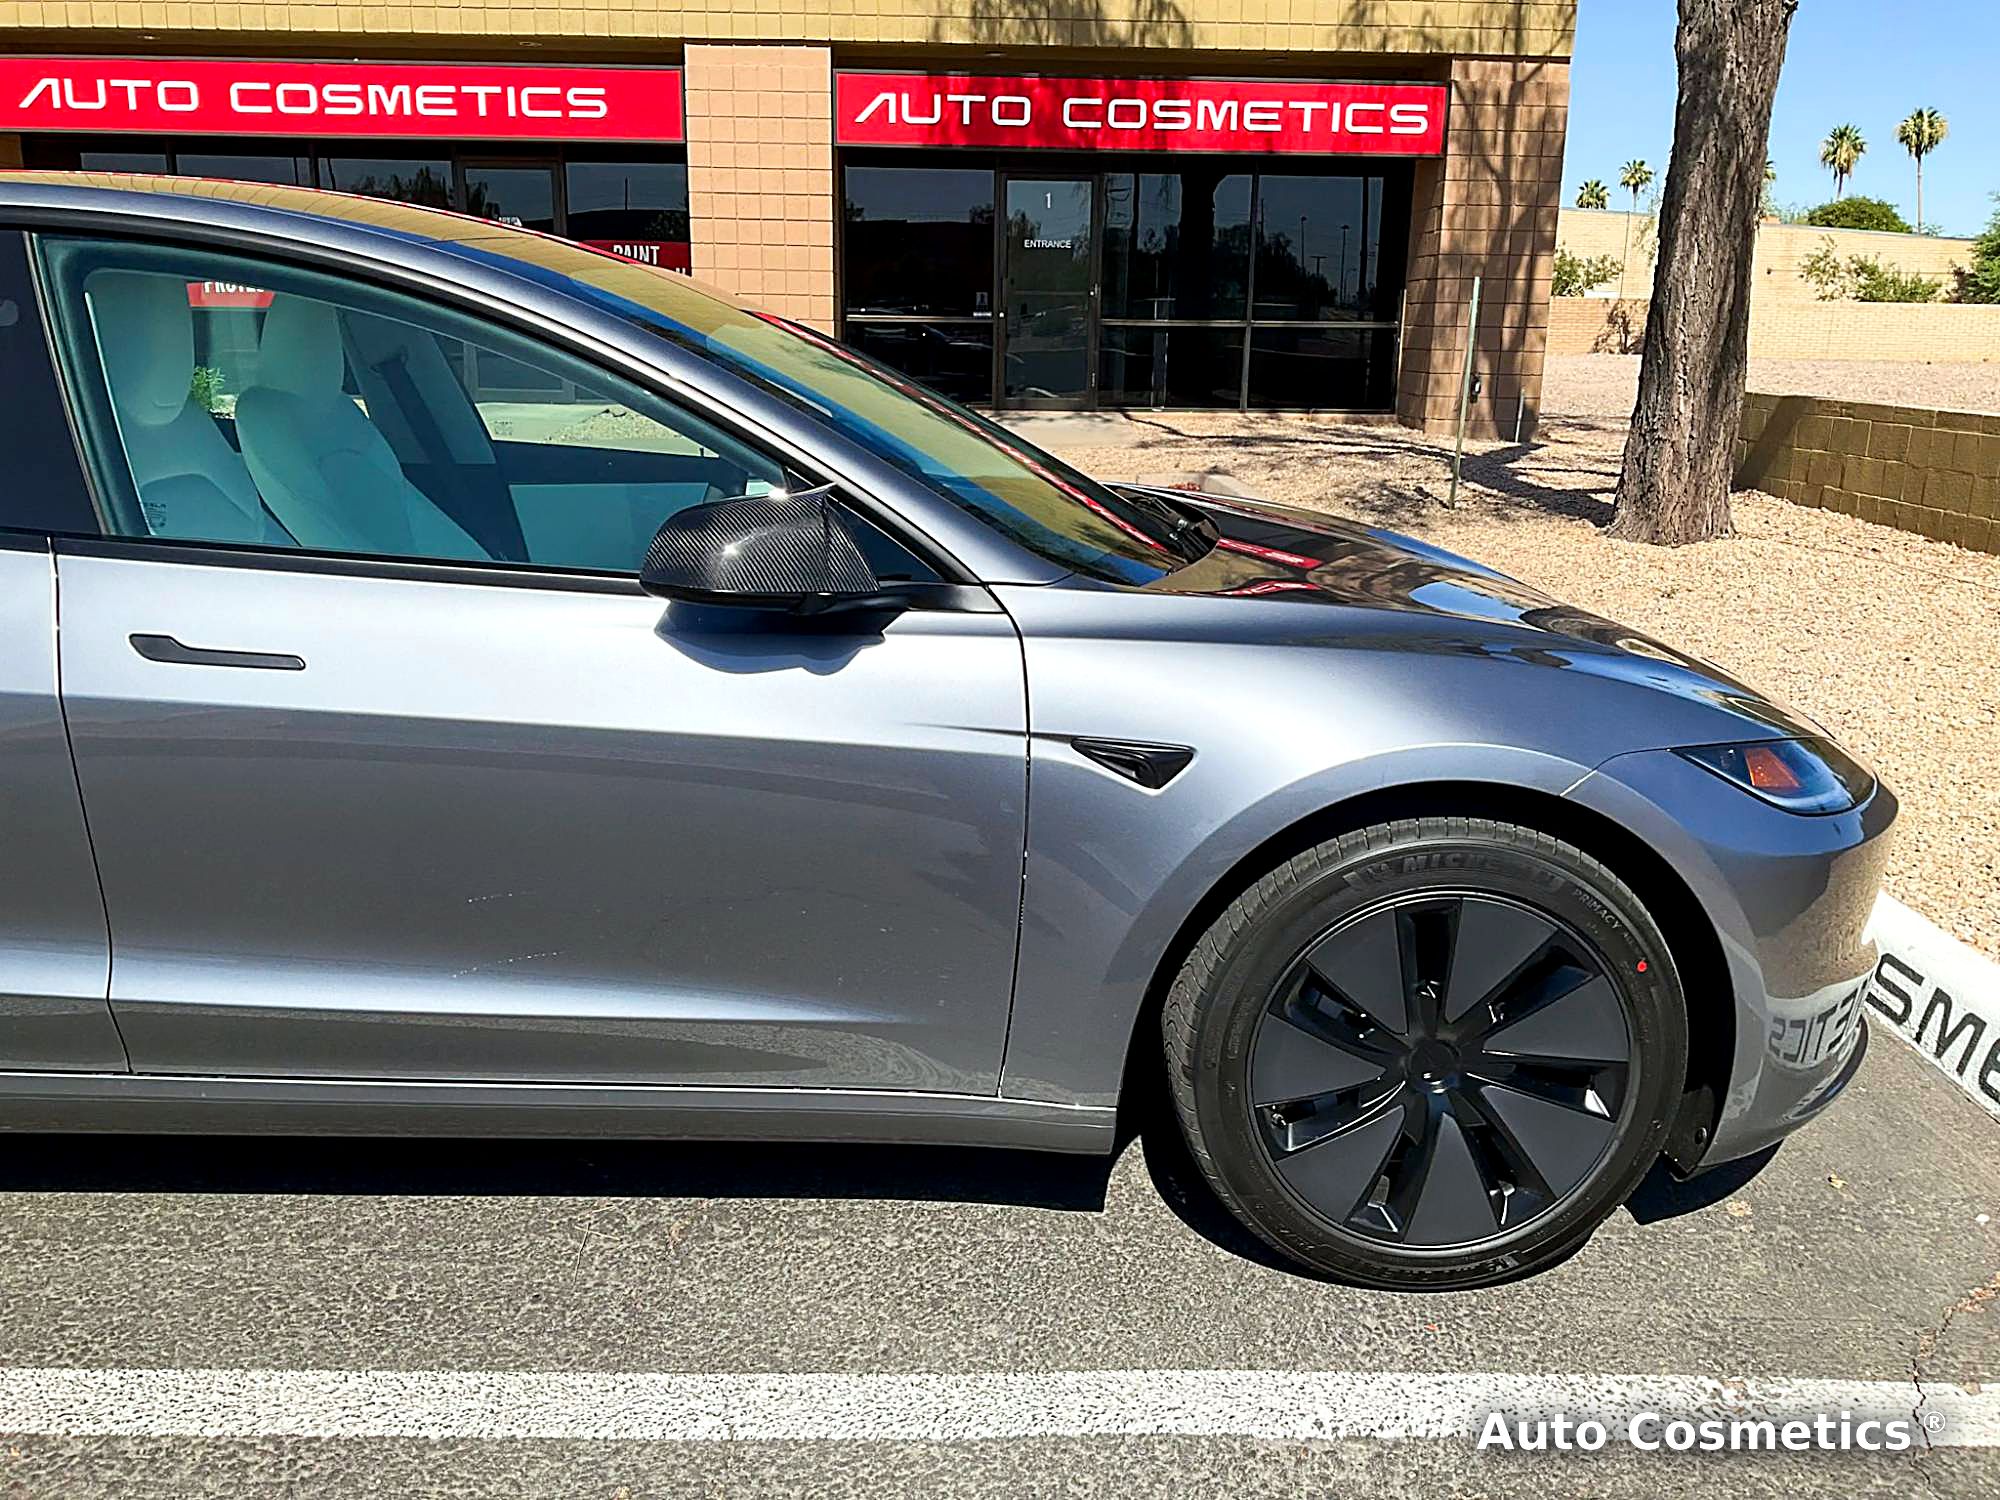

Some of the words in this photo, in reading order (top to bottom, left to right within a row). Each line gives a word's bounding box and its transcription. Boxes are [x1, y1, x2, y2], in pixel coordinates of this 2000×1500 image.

[19, 77, 199, 112] AUTO
[229, 81, 608, 119] COSMETICS
[853, 92, 1031, 126] AUTO
[1063, 97, 1428, 134] COSMETICS
[1044, 191, 1052, 209] 1
[1023, 239, 1072, 249] ENTRANCE
